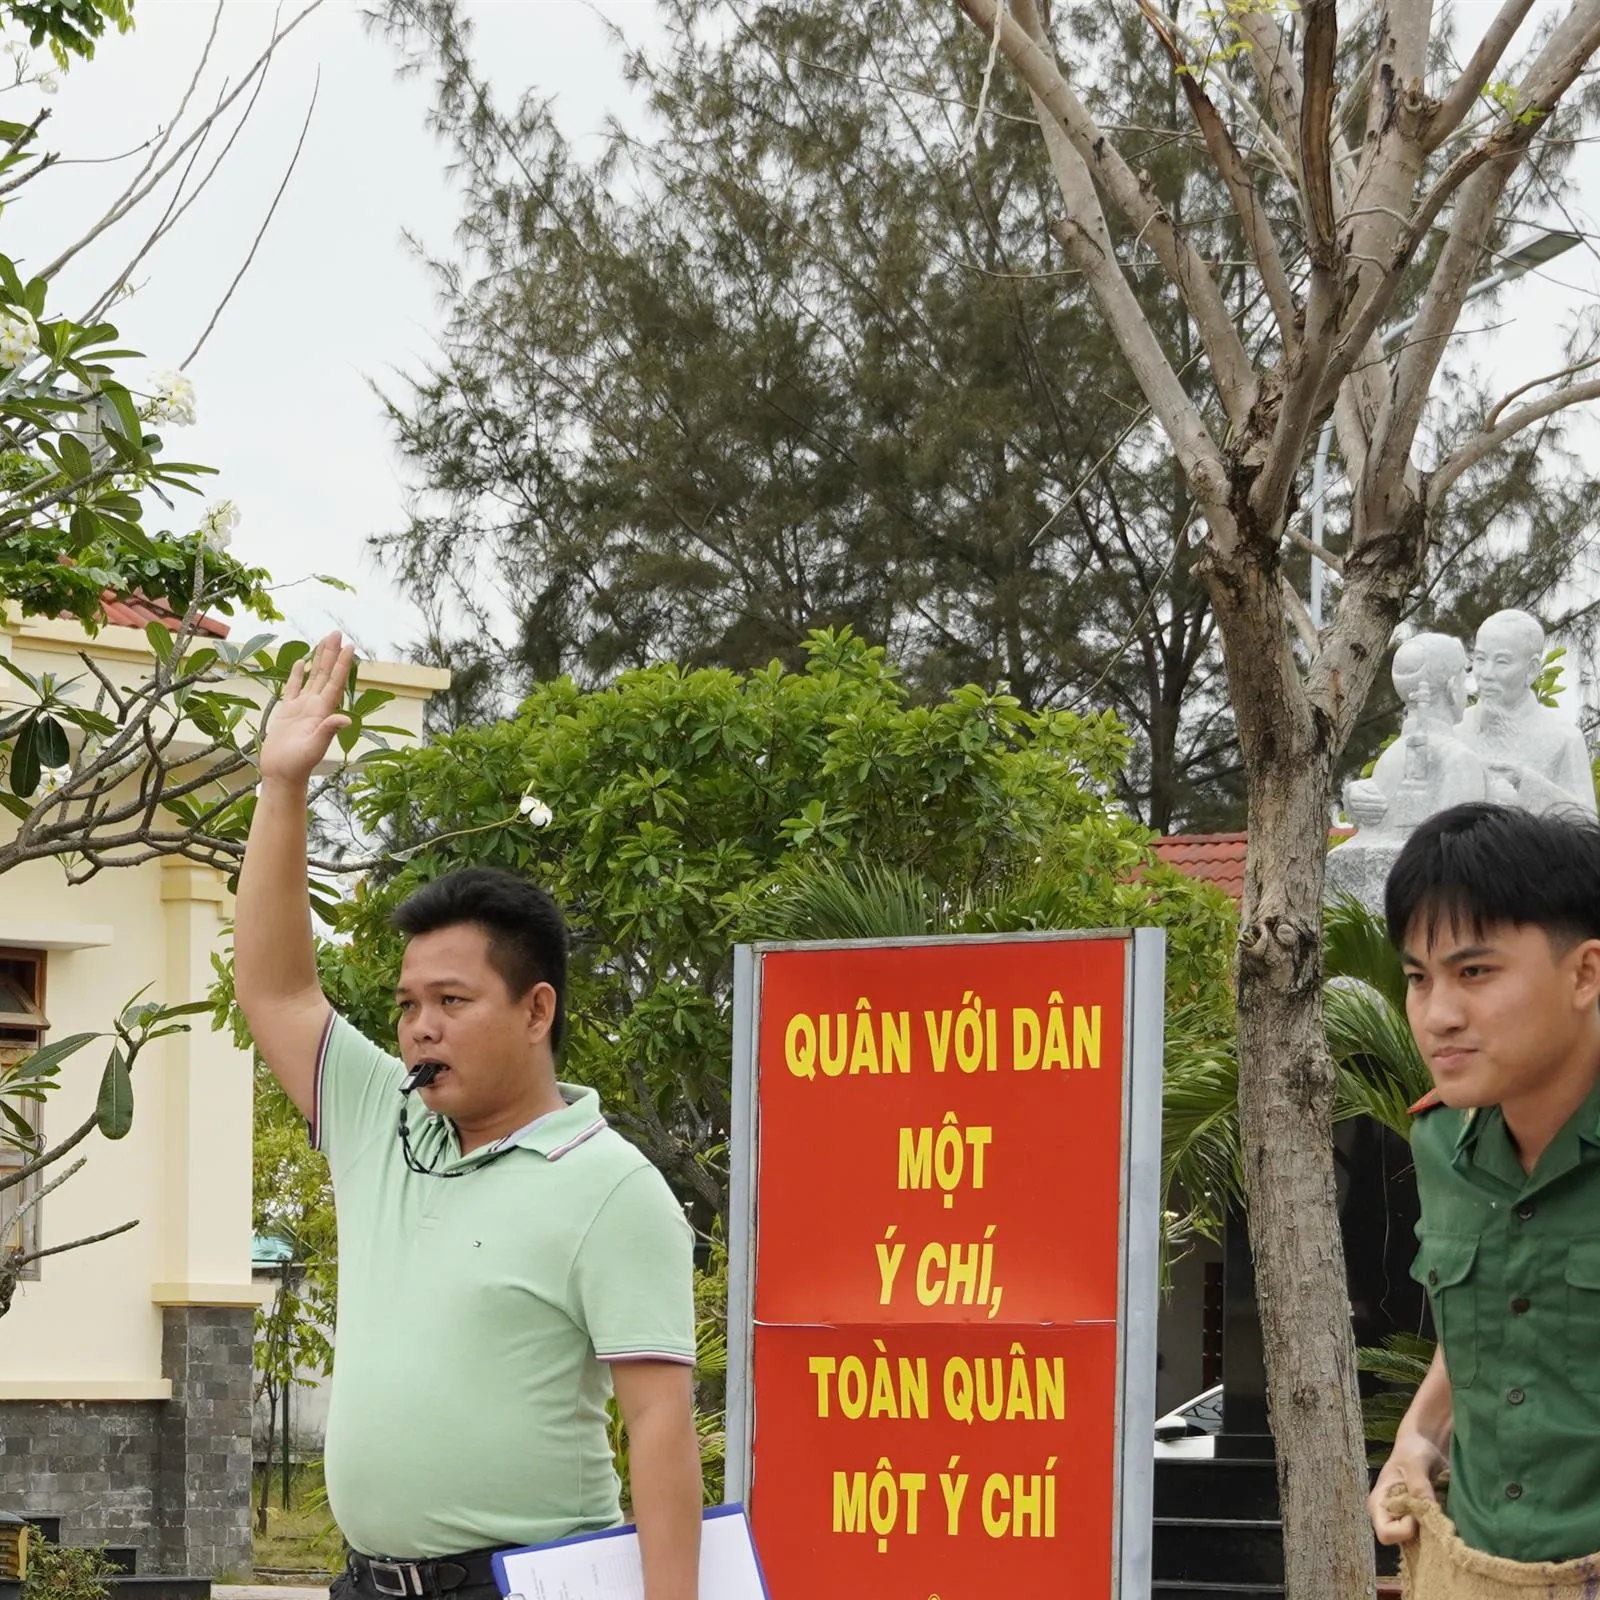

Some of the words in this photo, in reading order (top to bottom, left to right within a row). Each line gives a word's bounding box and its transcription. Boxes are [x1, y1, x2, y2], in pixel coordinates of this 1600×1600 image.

[785, 997, 911, 1078] QUÂN
[924, 990, 997, 1073] VỚI
[1013, 991, 1102, 1071] DÂN
[898, 1112, 992, 1209] MỘT
[876, 1225, 905, 1305] Ý
[916, 1225, 1003, 1316] CHÍ,
[809, 1339, 929, 1420] TOÀN
[943, 1343, 1066, 1424] QUÂN
[832, 1457, 926, 1554] MỘT
[940, 1455, 970, 1536] Ý
[982, 1456, 1058, 1538] CHÍ
